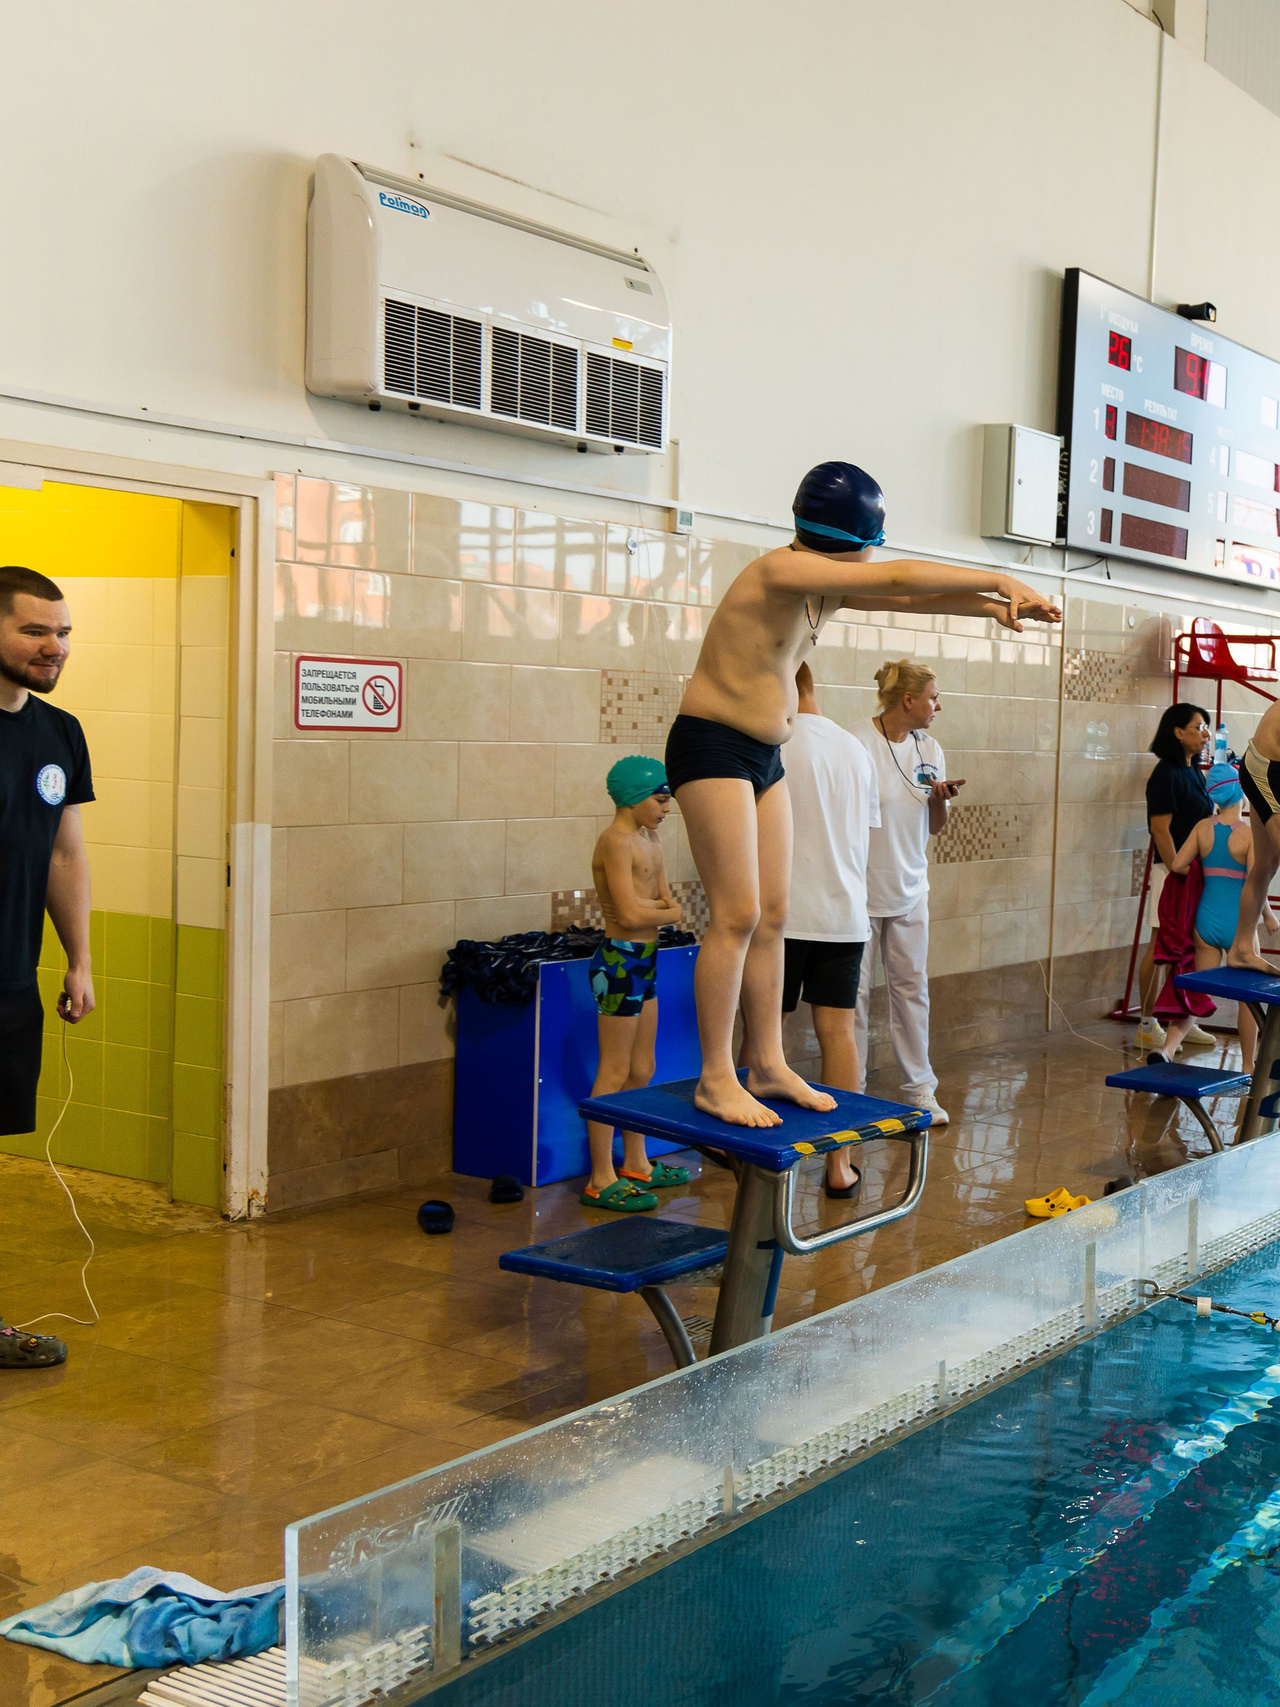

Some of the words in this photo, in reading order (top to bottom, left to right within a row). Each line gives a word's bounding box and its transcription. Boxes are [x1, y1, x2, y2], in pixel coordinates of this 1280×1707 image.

[1108, 331, 1130, 370] 26
[1190, 332, 1214, 355] ВРЕМЯ
[1101, 382, 1124, 403] МЕСТО
[1093, 407, 1100, 431] 1
[1089, 458, 1099, 483] 2
[1086, 511, 1096, 535] 3
[301, 668, 357, 680] ЗАПРЕЩАЕТСЯ
[301, 682, 360, 693] ПОЛЬЗОВАТЬСЯ
[301, 695, 357, 706] МОБИЛЬНЫМИ
[301, 708, 353, 719] ТЕЛЕФОНАМИ
